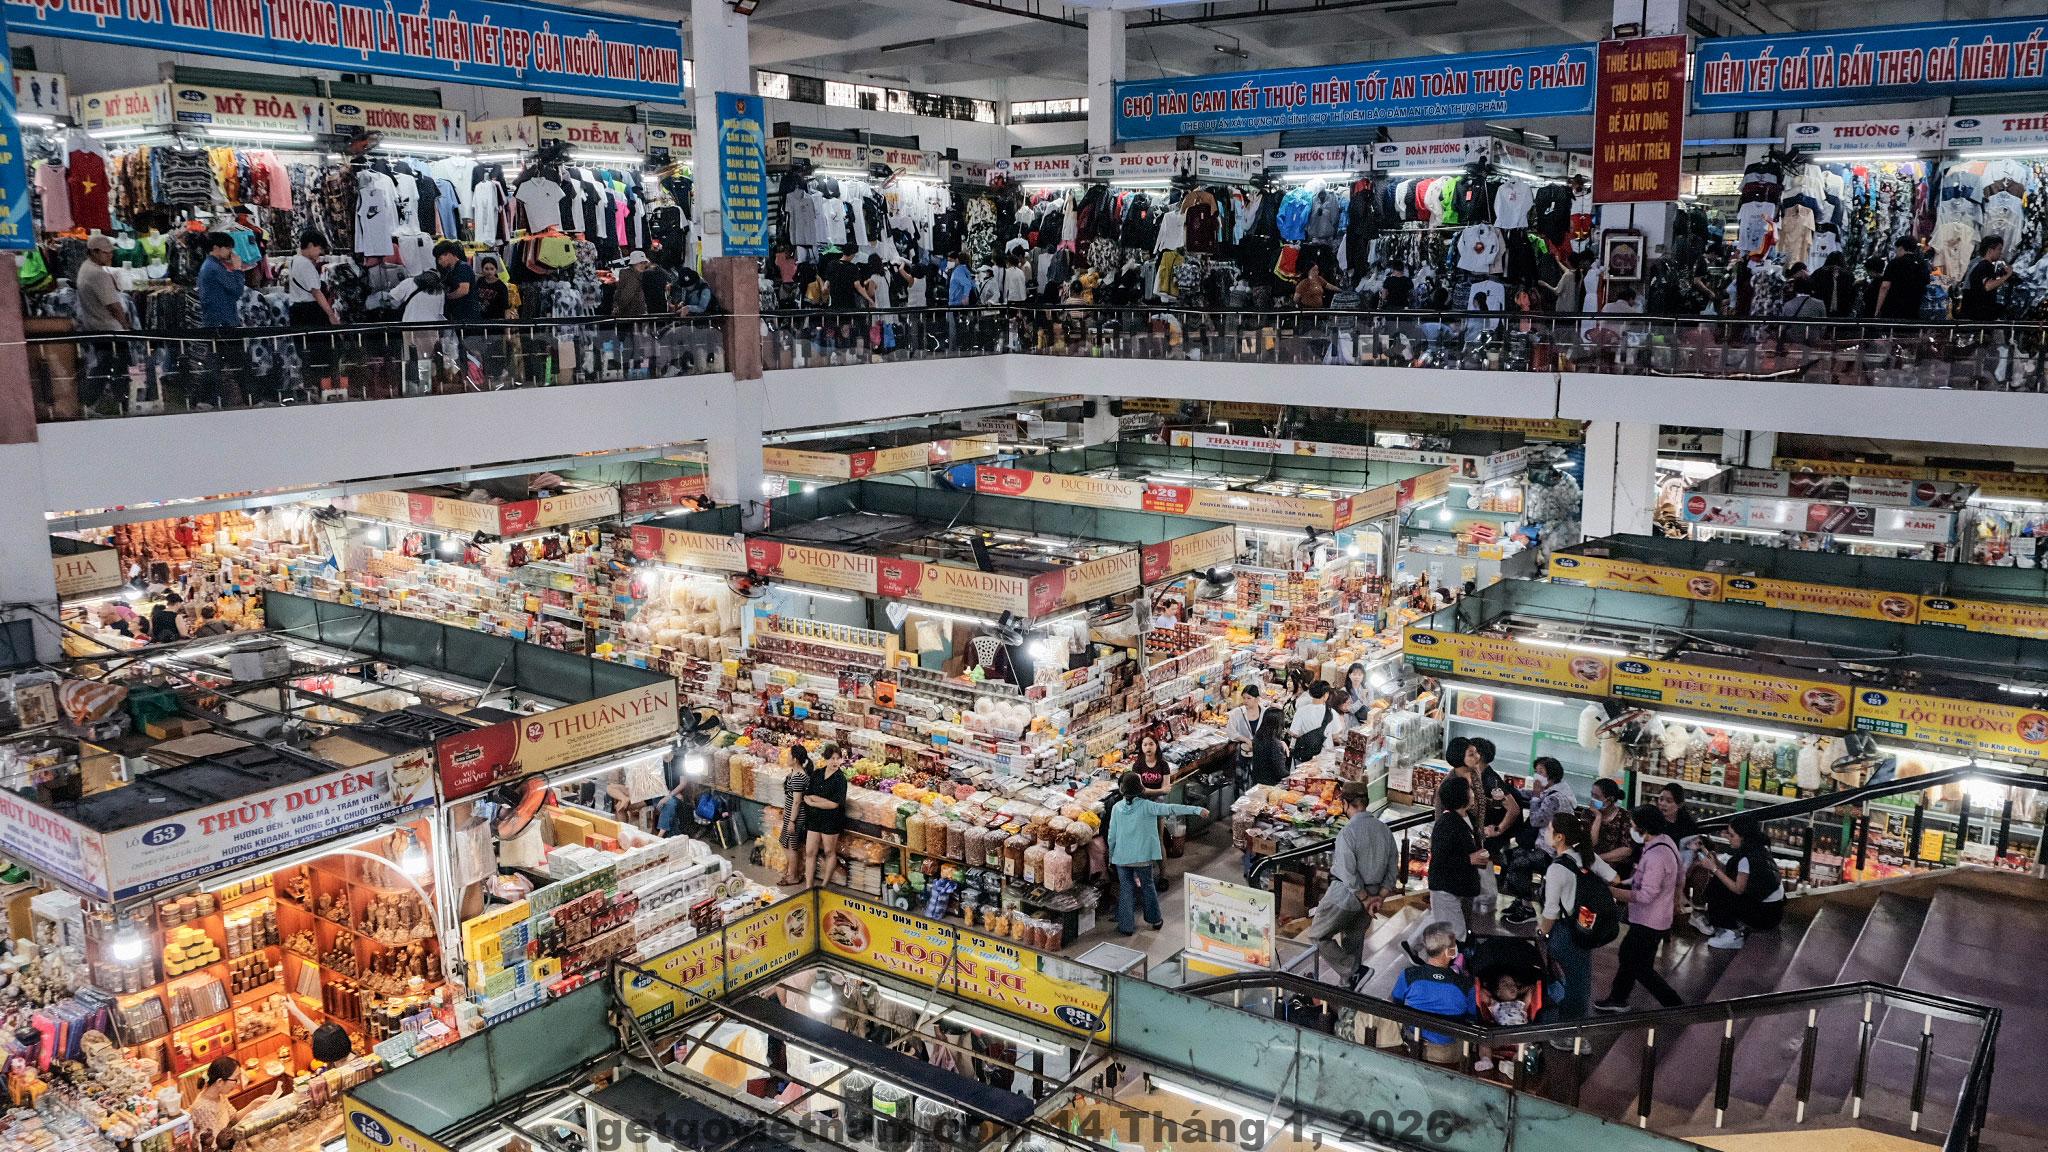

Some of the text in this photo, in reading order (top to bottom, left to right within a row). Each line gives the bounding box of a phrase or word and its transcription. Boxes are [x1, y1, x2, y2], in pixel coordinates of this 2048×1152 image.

[213, 0, 264, 38] MINH
[339, 4, 376, 61] MẠI
[376, 0, 400, 55] LÀ
[399, 0, 433, 59] THỂ
[432, 12, 471, 71] HIỆN
[471, 16, 501, 66] NÉT
[502, 27, 532, 78] ĐẸP
[533, 21, 564, 74] CỦA
[564, 29, 606, 77] NGƯỜI
[605, 41, 638, 80] KINH
[638, 45, 681, 86] DOANH
[1606, 48, 1629, 74] THUẾ
[1631, 52, 1643, 72] LÀ
[1702, 27, 2048, 95] NIÊM YẾT GIÁ VÀ BÁN THEO GIÁ NIÊM YẾT
[1123, 52, 1587, 122] CHỢ HÀN CAM KẾT THỰC HIỆN TỐT AN TOÀN THỰC PHẨM
[1611, 83, 1628, 102] THU
[1652, 75, 1670, 101] YẾU
[214, 92, 298, 119] MỸ HÒA
[413, 113, 437, 132] SEN
[1622, 110, 1641, 132] XÂY
[567, 122, 619, 145] DIỄM
[1604, 141, 1616, 163] VÀ
[1618, 140, 1643, 163] PHÁT
[1632, 168, 1659, 191] NƯỚC
[799, 548, 875, 574] SHOP NHI
[1079, 562, 1106, 580] NAM
[945, 570, 978, 590] NAM
[630, 688, 668, 718] YẾN
[528, 723, 542, 736] 52
[284, 770, 376, 813] DUYÊN
[152, 825, 178, 845] 53
[233, 826, 264, 841] HƯƠNG
[221, 842, 253, 857] HƯƠNG
[664, 953, 688, 971] GIA
[1010, 995, 1049, 1016] GIA
